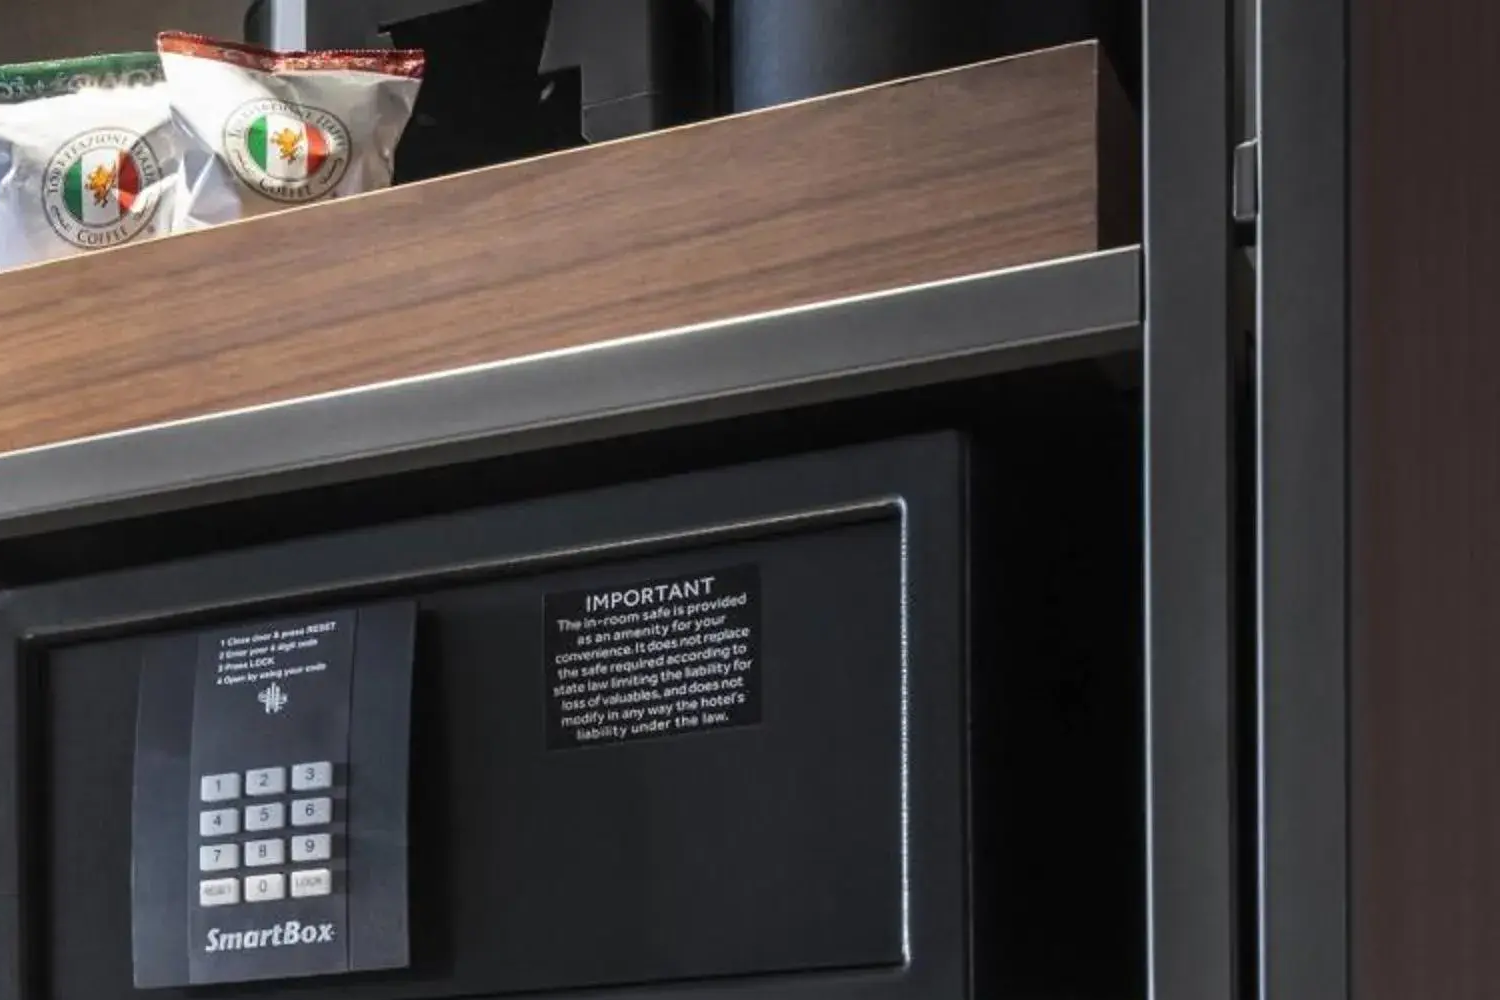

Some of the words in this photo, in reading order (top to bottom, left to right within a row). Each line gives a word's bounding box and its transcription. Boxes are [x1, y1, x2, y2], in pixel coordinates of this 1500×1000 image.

[77, 225, 129, 245] COFFEE
[586, 576, 715, 613] IMPORTANT
[557, 619, 582, 632] The
[583, 613, 640, 628] in-room
[642, 605, 671, 620] safe
[673, 603, 685, 616] is
[687, 592, 747, 616] provided
[577, 634, 592, 645] as
[595, 633, 611, 643] an
[613, 623, 669, 641] amenity
[671, 619, 691, 632] for
[694, 615, 726, 632] your
[635, 642, 646, 653] It
[647, 640, 678, 653] does
[679, 634, 702, 647] not
[703, 627, 751, 644] replace
[557, 668, 579, 680] the
[581, 663, 608, 676] safe
[609, 655, 665, 673] required
[666, 646, 731, 665] according
[732, 643, 747, 655] to
[553, 683, 586, 697] state
[587, 681, 608, 691] law
[611, 673, 659, 689] limiting
[660, 669, 683, 682] the
[684, 662, 731, 678] liability
[733, 658, 753, 671] for
[562, 699, 586, 711] loss
[587, 693, 602, 708] of
[663, 682, 688, 697] and
[688, 681, 719, 694] does
[721, 676, 744, 690] not
[561, 711, 605, 728] modify
[607, 710, 619, 721] in
[622, 708, 645, 721] any
[647, 704, 673, 717] way
[676, 699, 699, 711] the
[576, 725, 627, 740] liability
[631, 719, 671, 734] under
[675, 715, 699, 729] the
[702, 711, 729, 725] law.
[215, 779, 221, 793] 1
[260, 773, 269, 787] 2
[305, 767, 315, 781] 3
[213, 815, 222, 826] 4
[260, 806, 269, 822] 5
[305, 803, 315, 817] 6
[213, 849, 222, 863] 7
[259, 844, 267, 858] 8
[305, 839, 315, 853] 9
[259, 879, 268, 894] 0
[205, 920, 334, 953] SmartBox
